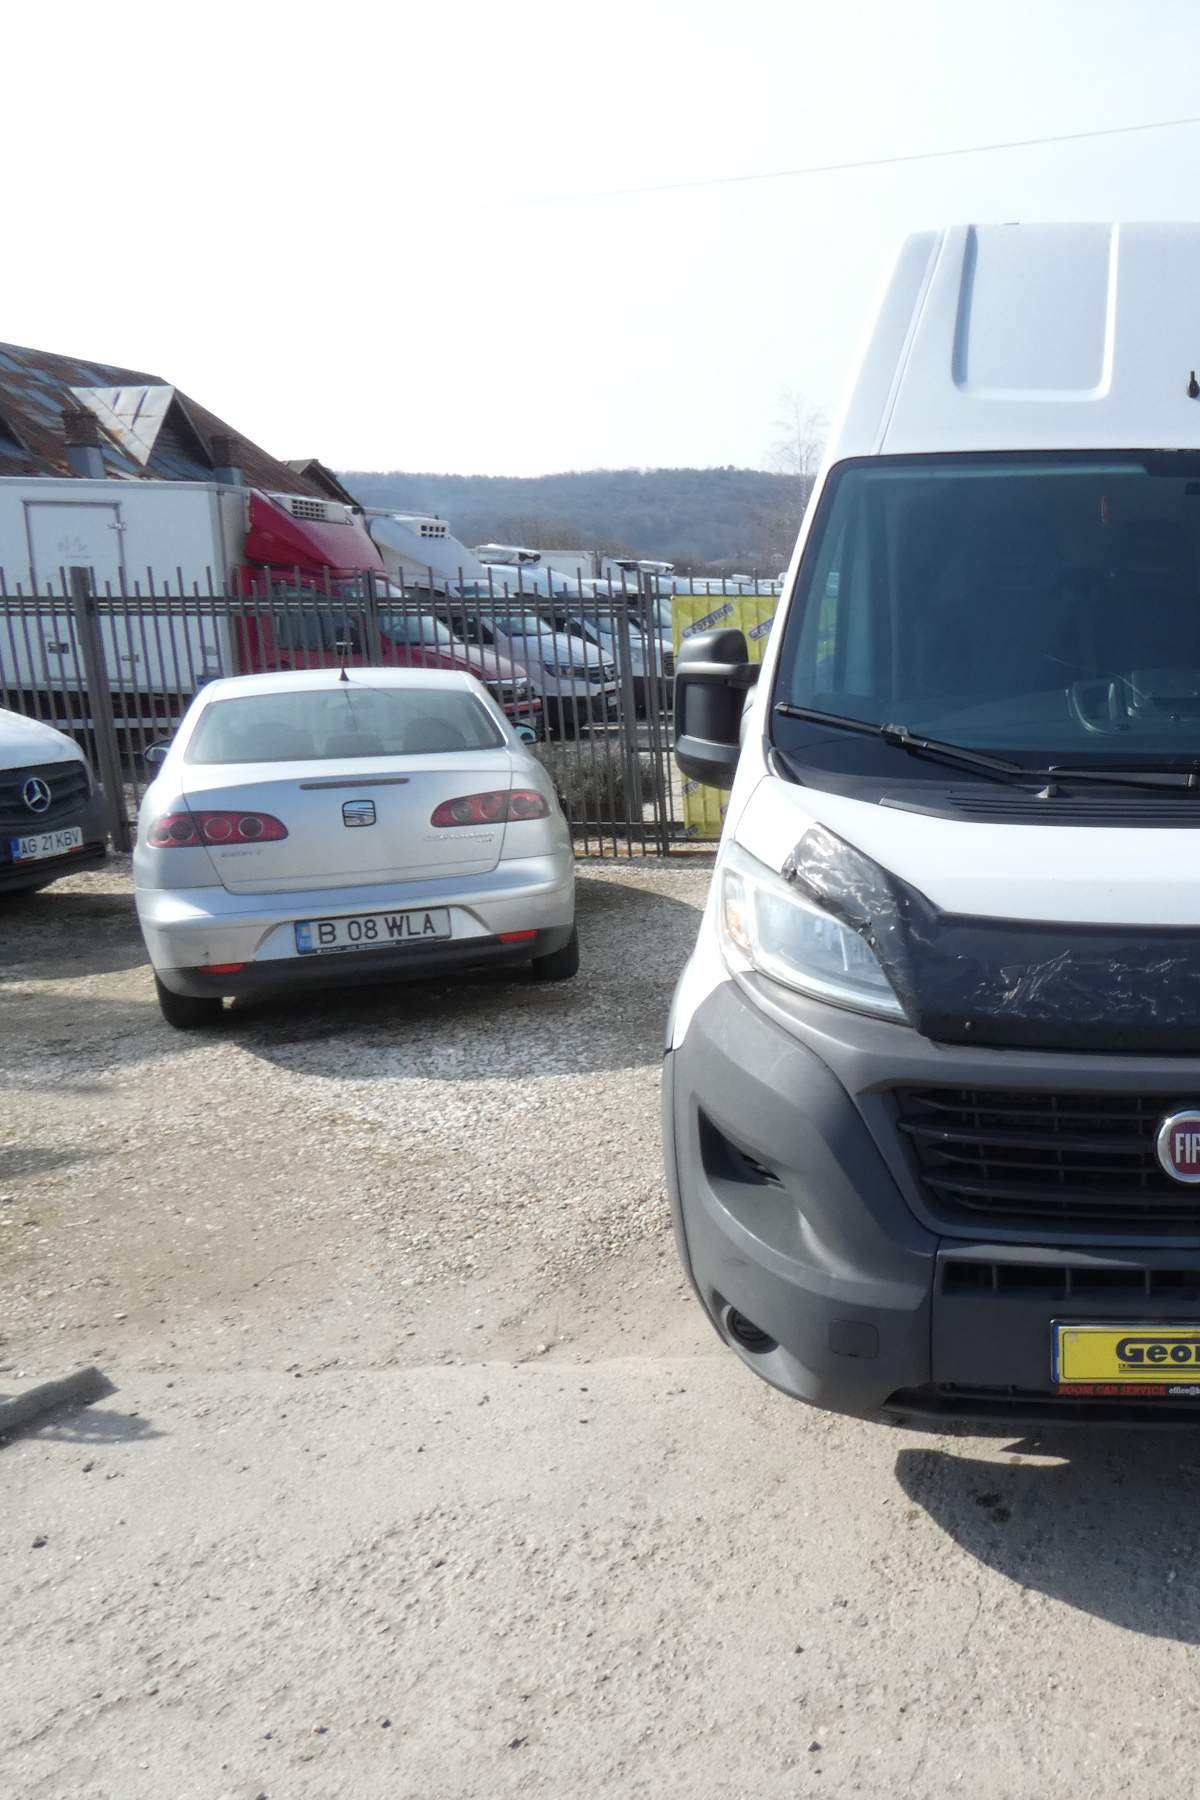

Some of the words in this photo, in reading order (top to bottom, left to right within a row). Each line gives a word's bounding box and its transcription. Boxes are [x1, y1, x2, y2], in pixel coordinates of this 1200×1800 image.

[22, 838, 37, 854] AG
[41, 835, 53, 850] 21
[56, 829, 80, 848] KBV
[318, 922, 337, 945] B
[347, 919, 378, 941] 08
[384, 913, 436, 938] WLA
